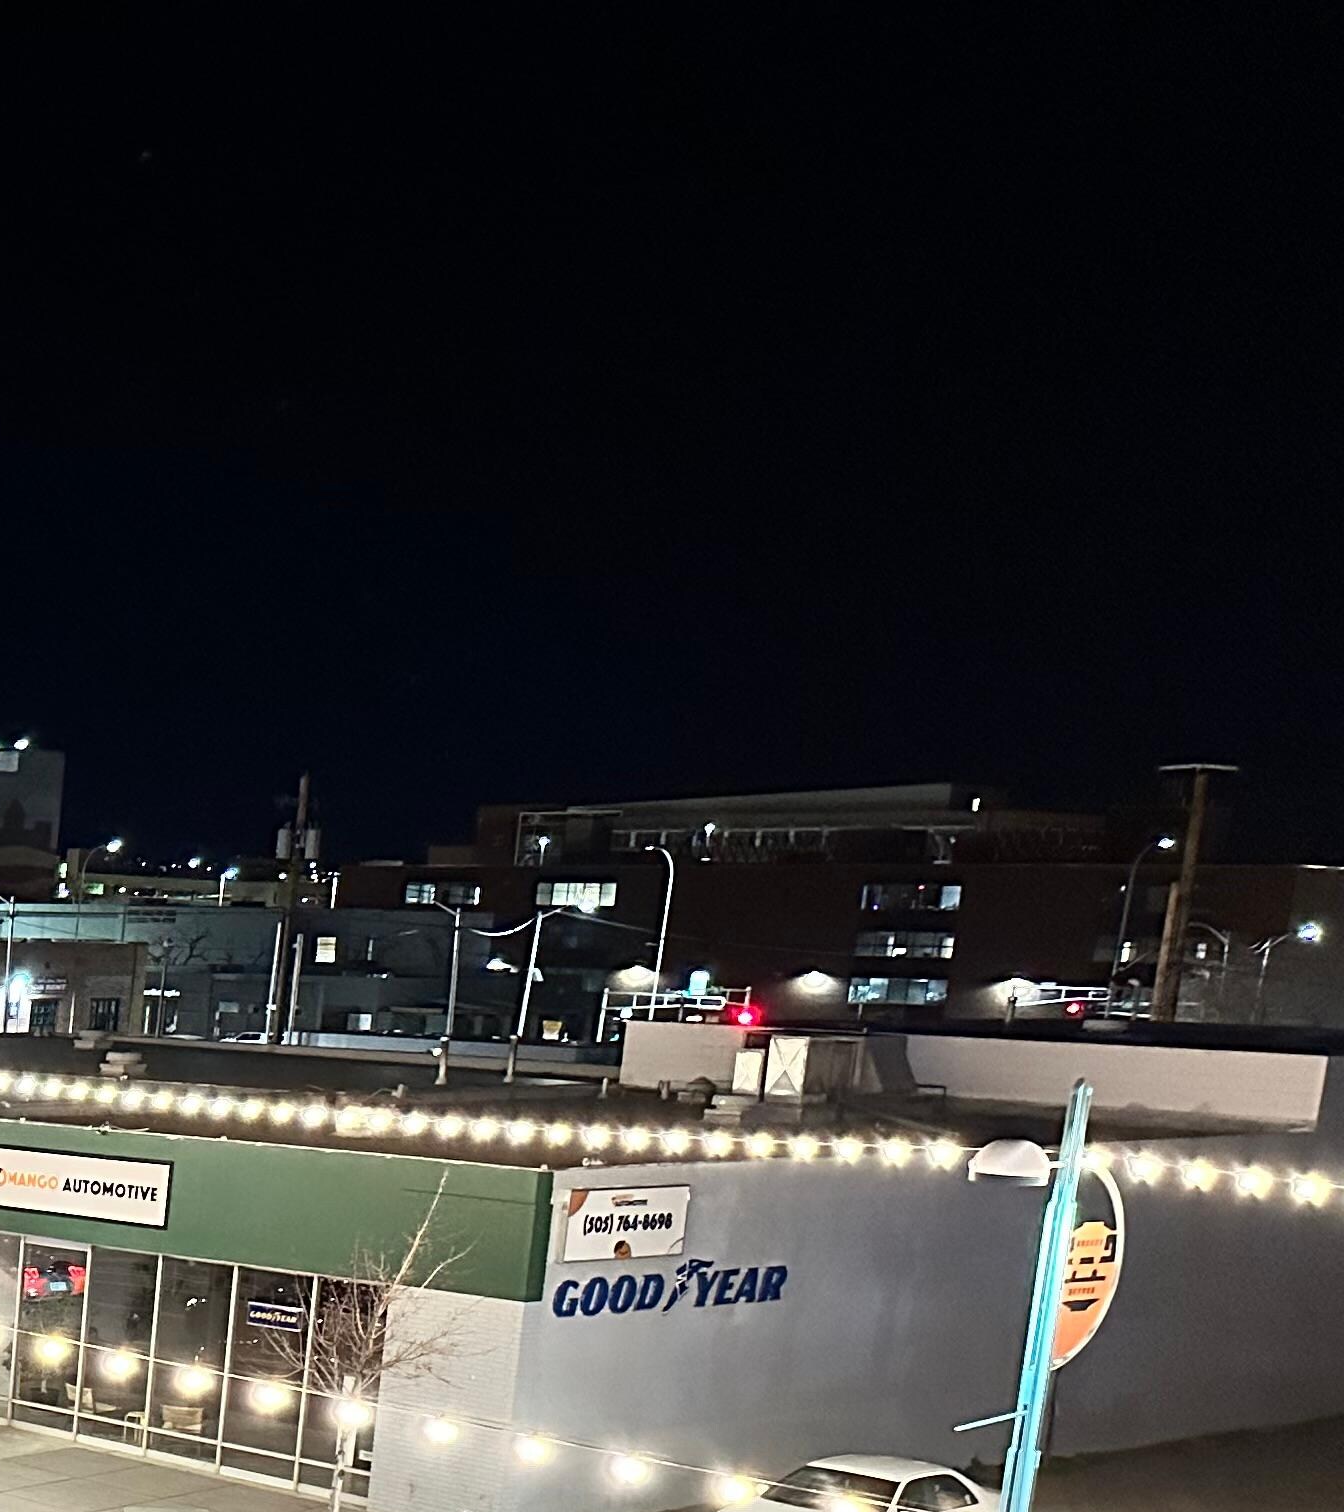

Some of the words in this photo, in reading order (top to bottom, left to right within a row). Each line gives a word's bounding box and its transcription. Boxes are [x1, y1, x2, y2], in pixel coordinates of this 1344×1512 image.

[62, 1178, 158, 1202] AUTOMOTIVE
[583, 1213, 614, 1236] (505)
[616, 1212, 673, 1232] 764-8698
